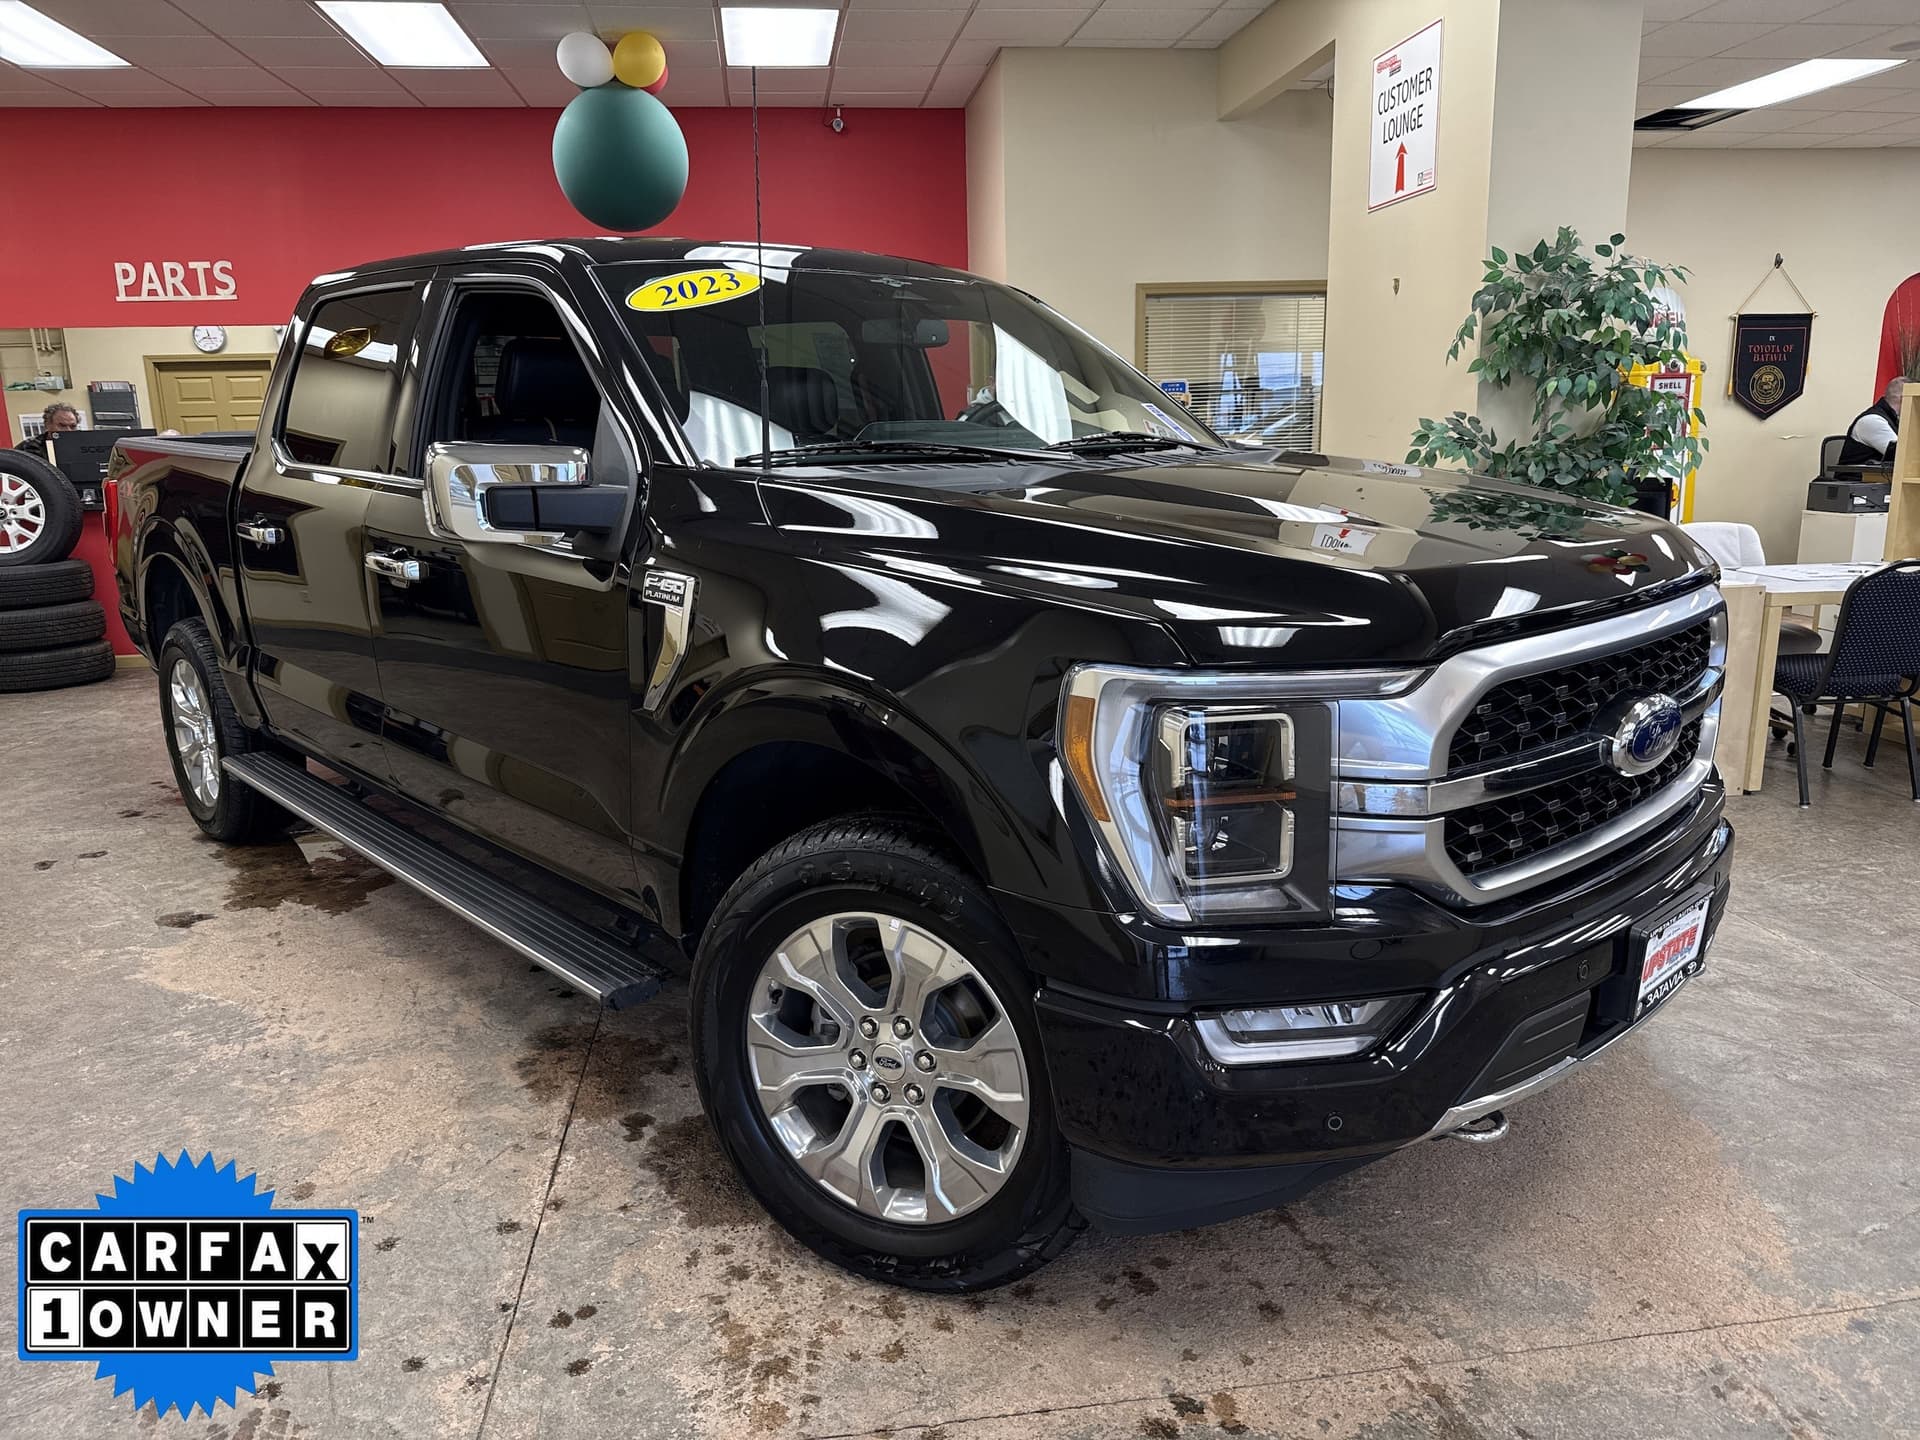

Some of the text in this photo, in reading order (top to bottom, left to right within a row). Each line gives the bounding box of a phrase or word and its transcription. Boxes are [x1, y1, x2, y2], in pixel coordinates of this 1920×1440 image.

[1378, 67, 1433, 115] CUSTOMER
[1383, 104, 1424, 144] LOUNGE
[113, 260, 237, 299] PARTS
[655, 272, 741, 306] 2023
[1748, 344, 1794, 353] TOYOTA OF
[1753, 353, 1787, 362] BATAVIA
[1658, 381, 1682, 390] SHELL
[645, 589, 681, 603] PLATINUM
[1643, 713, 1677, 756] Ford
[1641, 924, 1699, 983] UPSTATE
[879, 1057, 898, 1069] Ford
